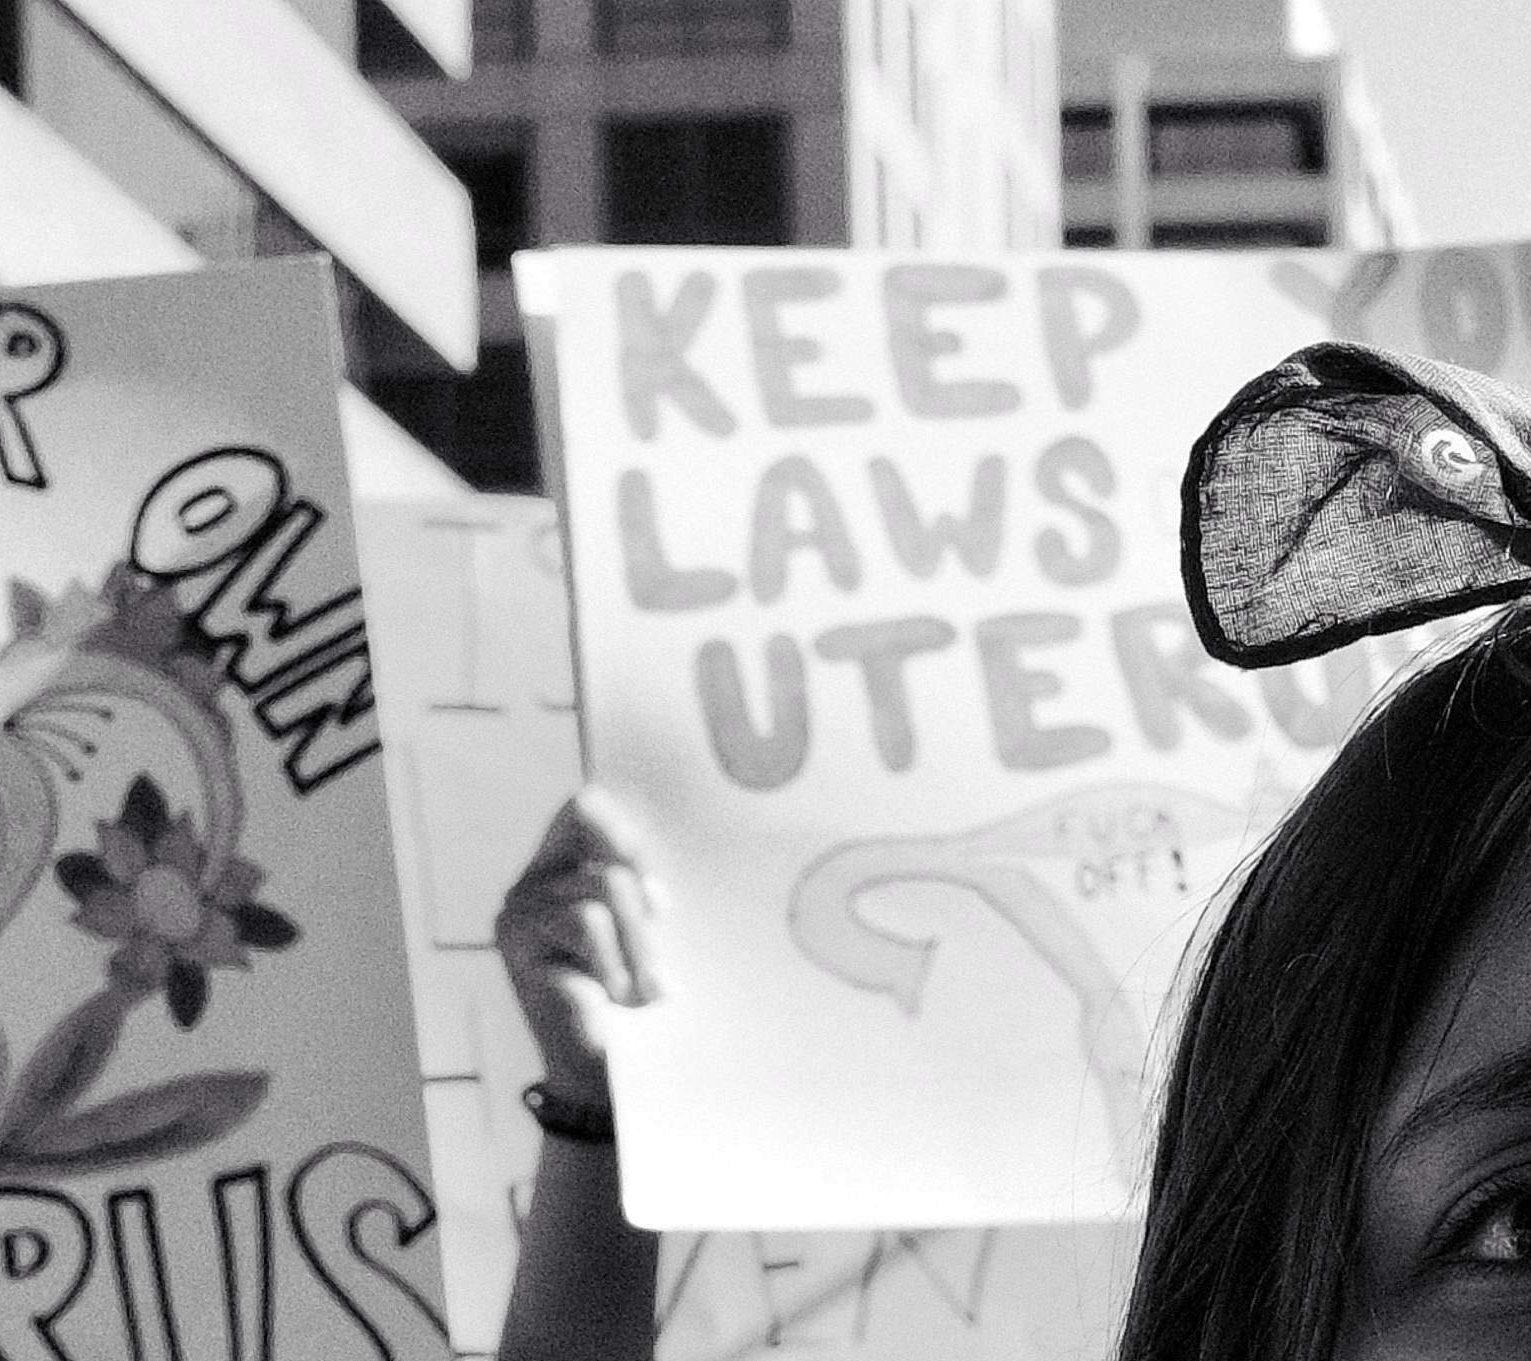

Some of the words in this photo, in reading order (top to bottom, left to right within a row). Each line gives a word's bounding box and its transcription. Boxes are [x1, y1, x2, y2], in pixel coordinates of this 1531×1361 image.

[613, 262, 1143, 442] KEEP
[613, 435, 1124, 612] LAWS
[129, 446, 384, 795] OWN
[695, 602, 1457, 792] UTERU
